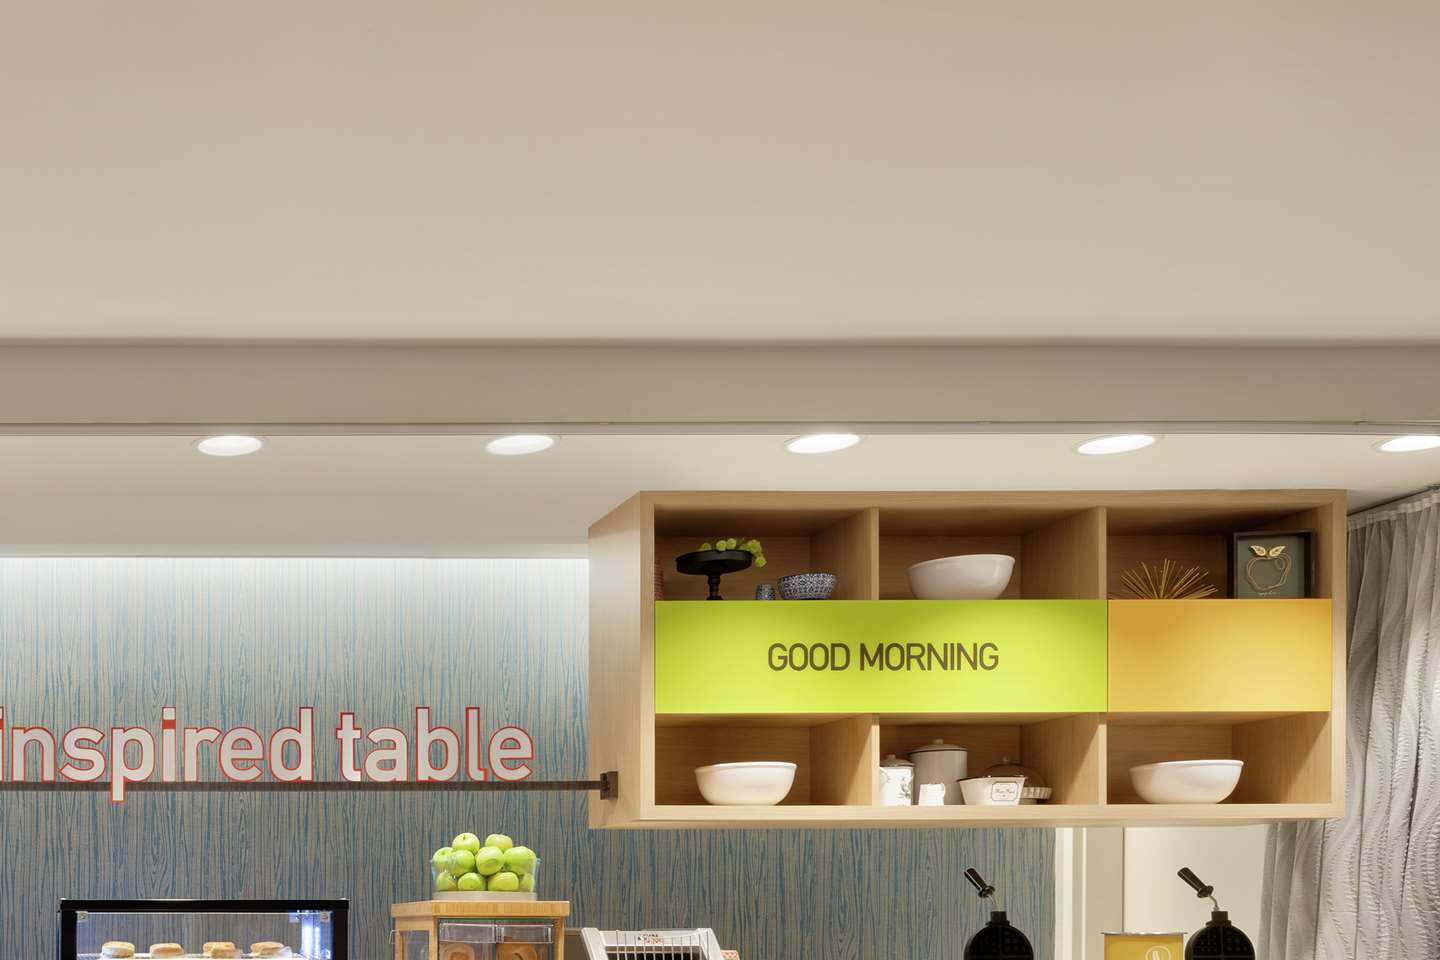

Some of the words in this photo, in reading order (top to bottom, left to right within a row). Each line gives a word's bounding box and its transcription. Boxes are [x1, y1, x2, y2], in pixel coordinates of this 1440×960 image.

[768, 643, 850, 671] GOOD
[860, 643, 999, 671] MORNING
[337, 706, 534, 782] table
